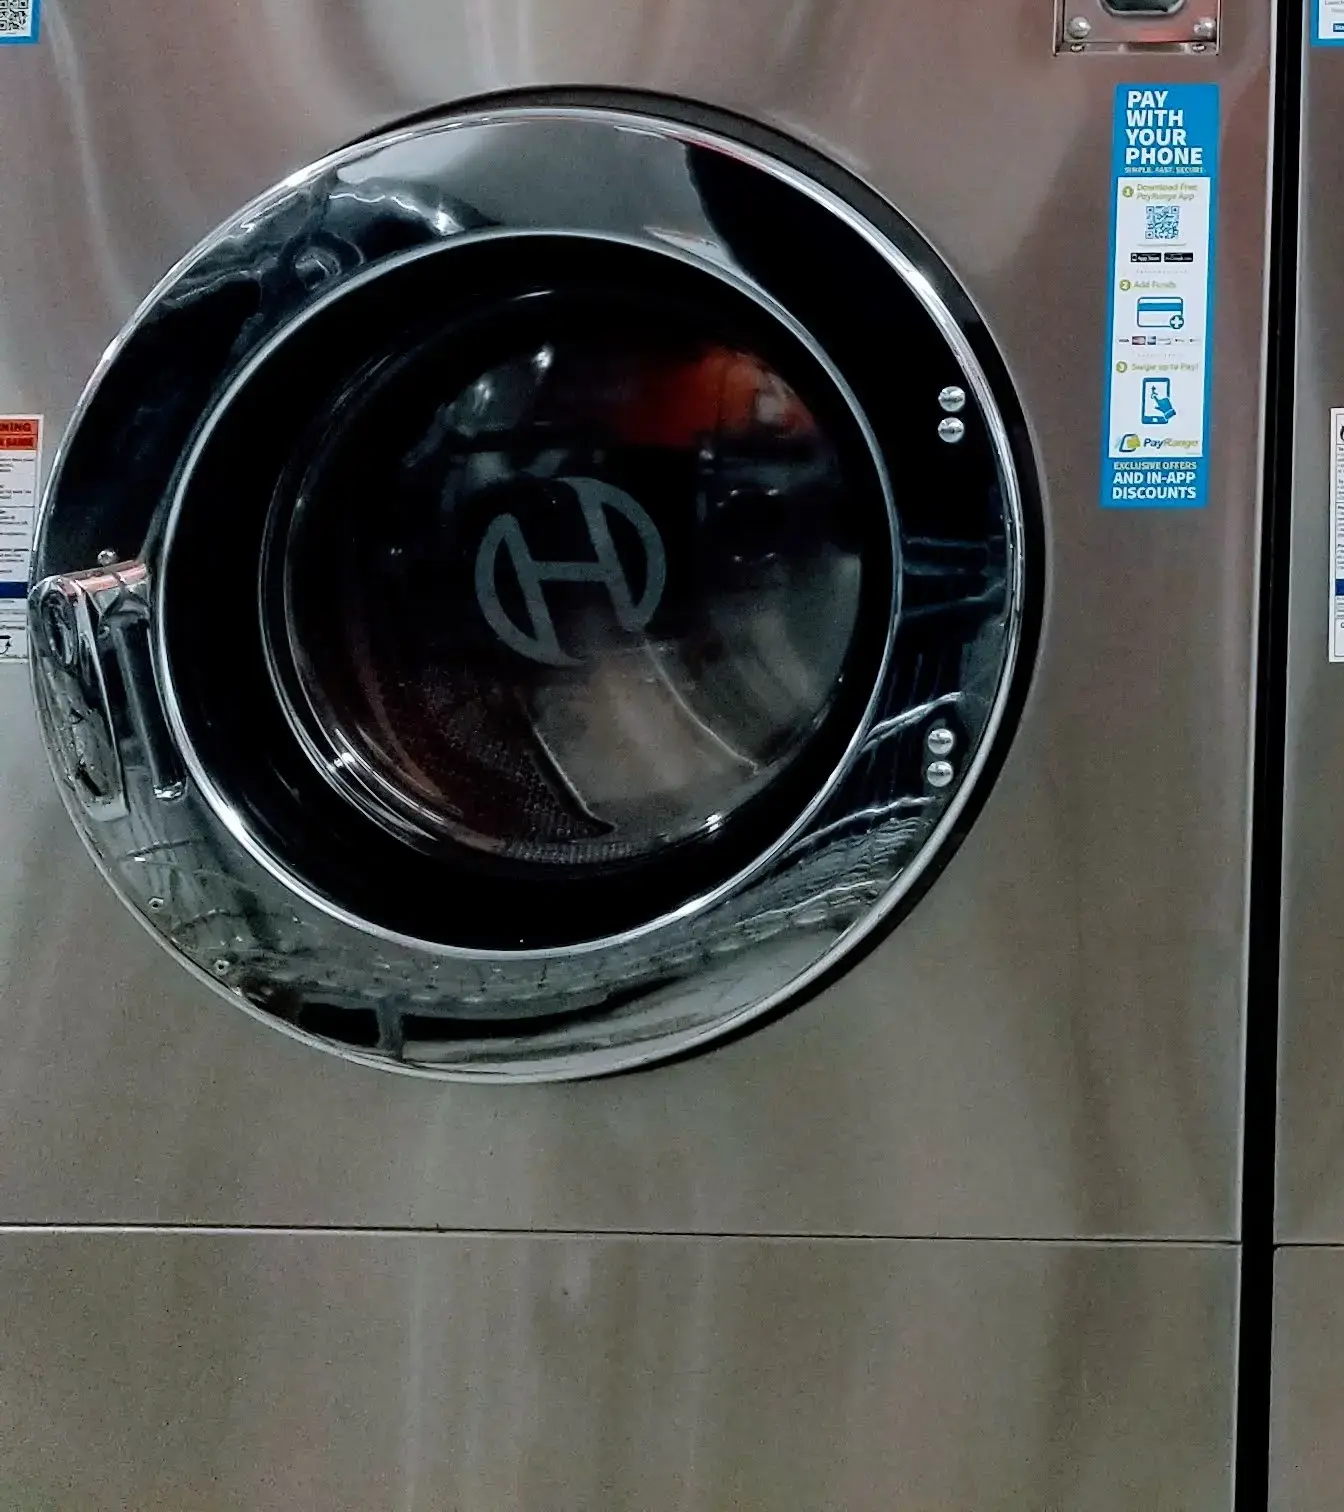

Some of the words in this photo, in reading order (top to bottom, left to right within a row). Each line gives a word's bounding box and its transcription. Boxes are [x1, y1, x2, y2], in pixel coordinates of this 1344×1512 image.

[1127, 90, 1169, 108] PAY
[1126, 109, 1184, 127] WITH
[1125, 128, 1187, 147] YOUR
[1125, 147, 1203, 165] PHONE
[0, 422, 32, 433] NING
[1143, 439, 1198, 450] PayRange
[1113, 472, 1144, 484] AND
[1147, 472, 1196, 484] IN-APP
[1112, 486, 1197, 500] DISCOUNTS
